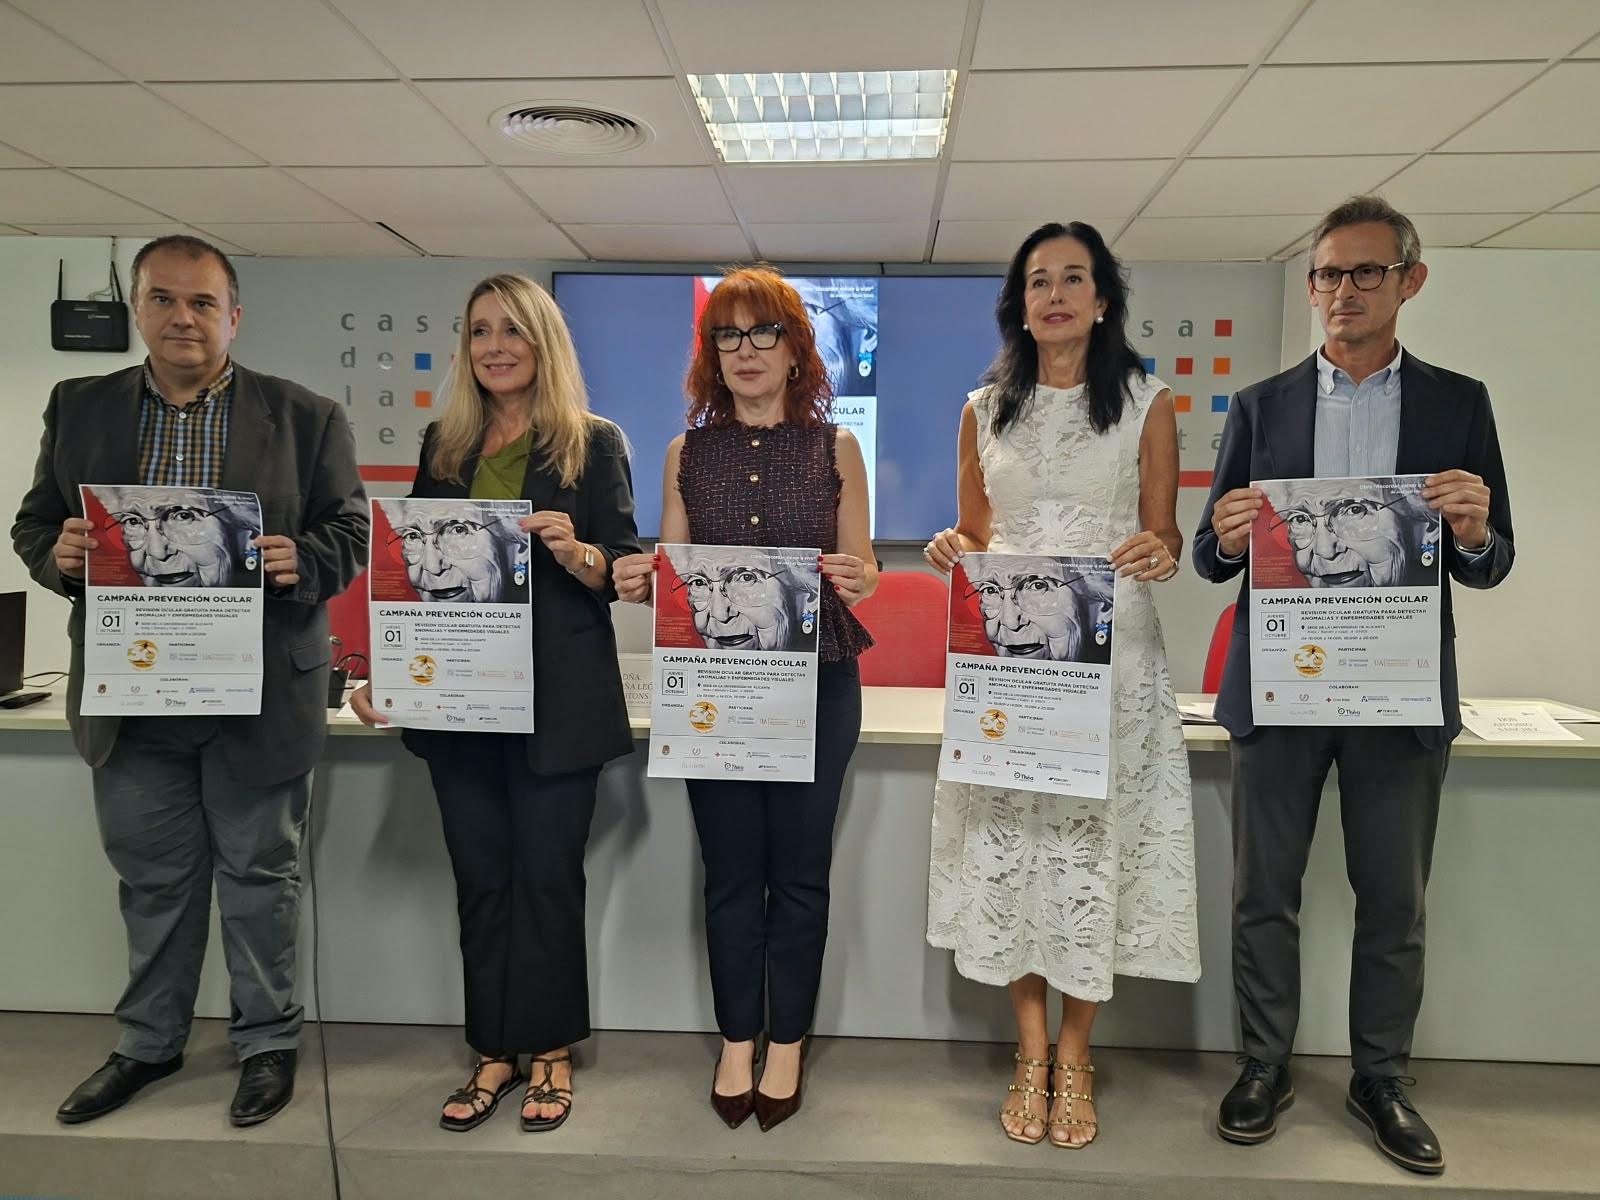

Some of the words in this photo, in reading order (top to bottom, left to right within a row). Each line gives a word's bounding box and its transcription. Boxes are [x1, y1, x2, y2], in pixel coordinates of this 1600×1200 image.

[340, 313, 462, 333] casa
[340, 346, 394, 370] de
[346, 384, 394, 407] la
[148, 594, 210, 602] PREVENCIÓN
[1261, 596, 1311, 604] CAMPAÑA
[1315, 595, 1382, 604] PREVENCIÓN
[426, 610, 482, 618] PREVENCIÓN
[102, 616, 120, 627] 01
[1266, 620, 1285, 631] 01
[385, 631, 401, 641] 01
[710, 657, 768, 666] PREVENCIÓN
[955, 662, 998, 672] CAMPAÑA
[1001, 666, 1059, 676] PREVENCIÓN
[1062, 671, 1100, 680] OCULAR
[667, 676, 684, 688] 01
[959, 683, 975, 695] 01
